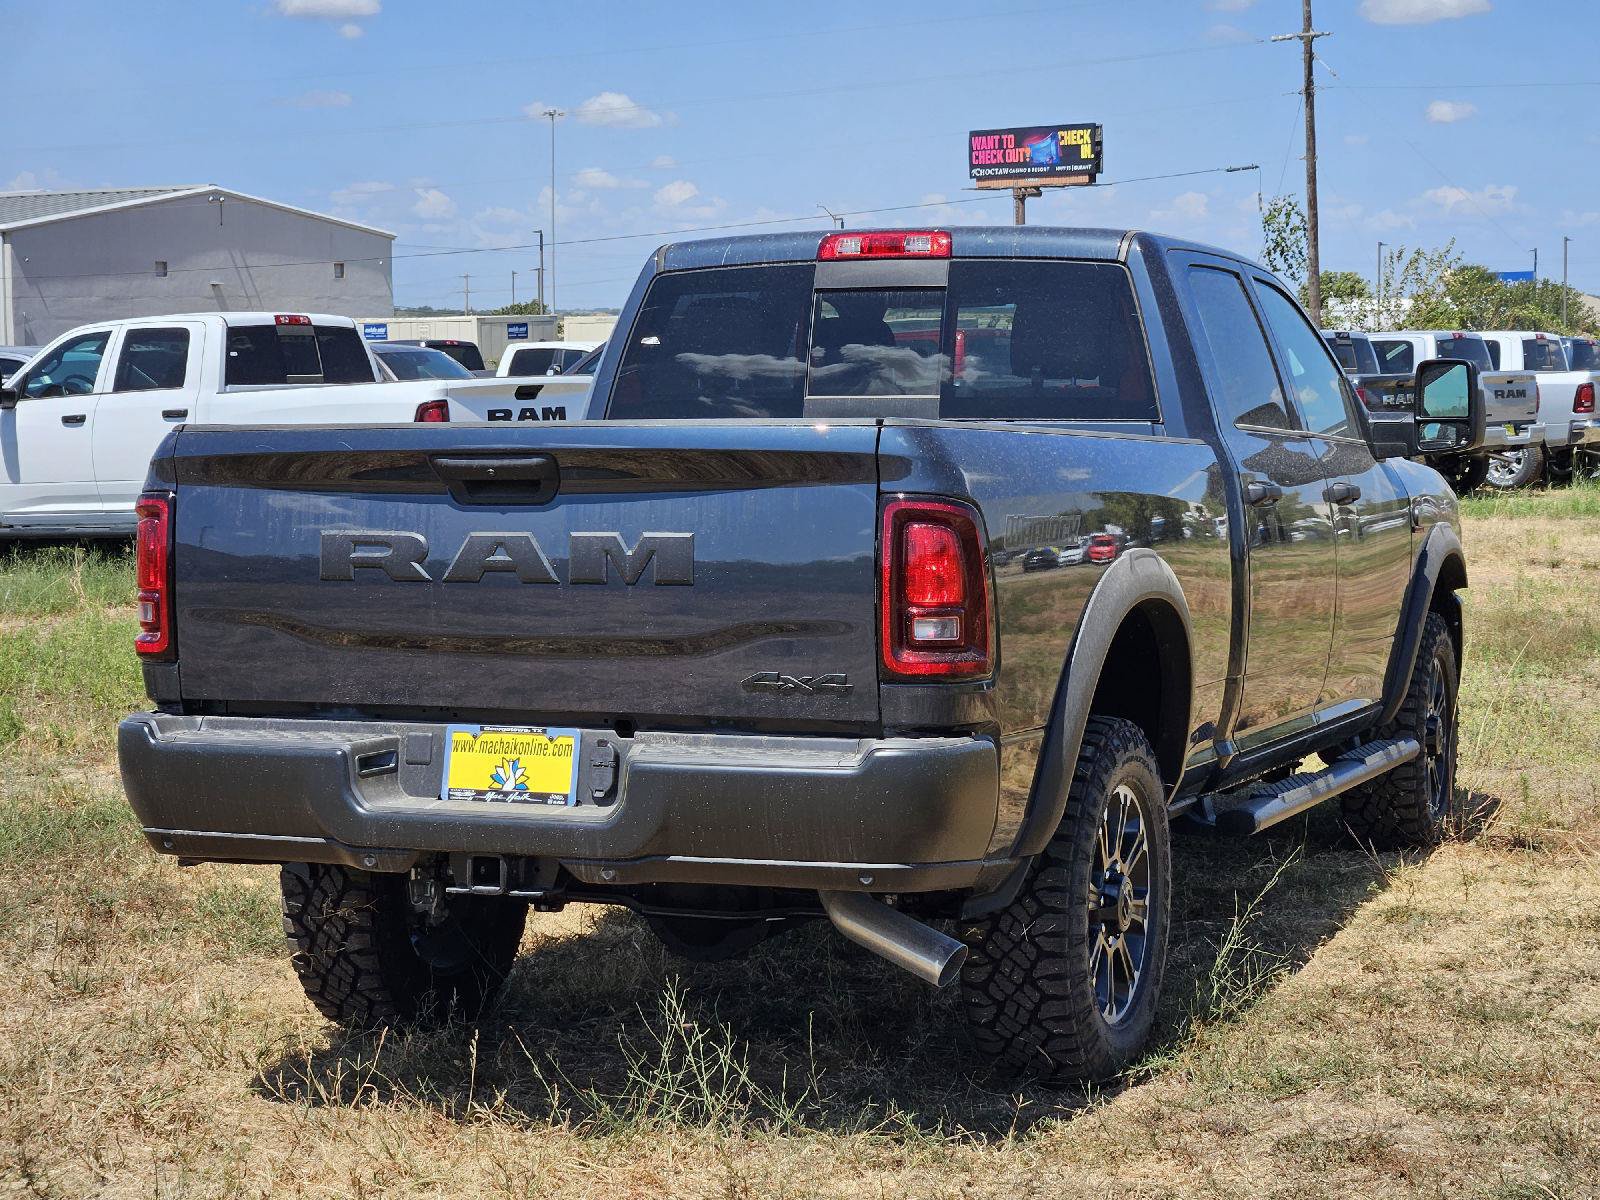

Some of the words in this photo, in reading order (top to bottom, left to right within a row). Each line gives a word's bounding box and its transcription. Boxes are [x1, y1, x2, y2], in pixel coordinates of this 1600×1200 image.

[971, 135, 999, 150] WANT
[1001, 134, 1014, 149] TO
[1058, 129, 1092, 145] CHECK
[972, 149, 1005, 164] CHECK
[1005, 147, 1031, 163] OUT?
[974, 167, 1009, 177] CHOCTAW
[1494, 389, 1526, 399] RAM
[487, 406, 566, 422] RAM
[320, 530, 694, 586] RAM
[452, 737, 573, 757] www.machaikonline.com
